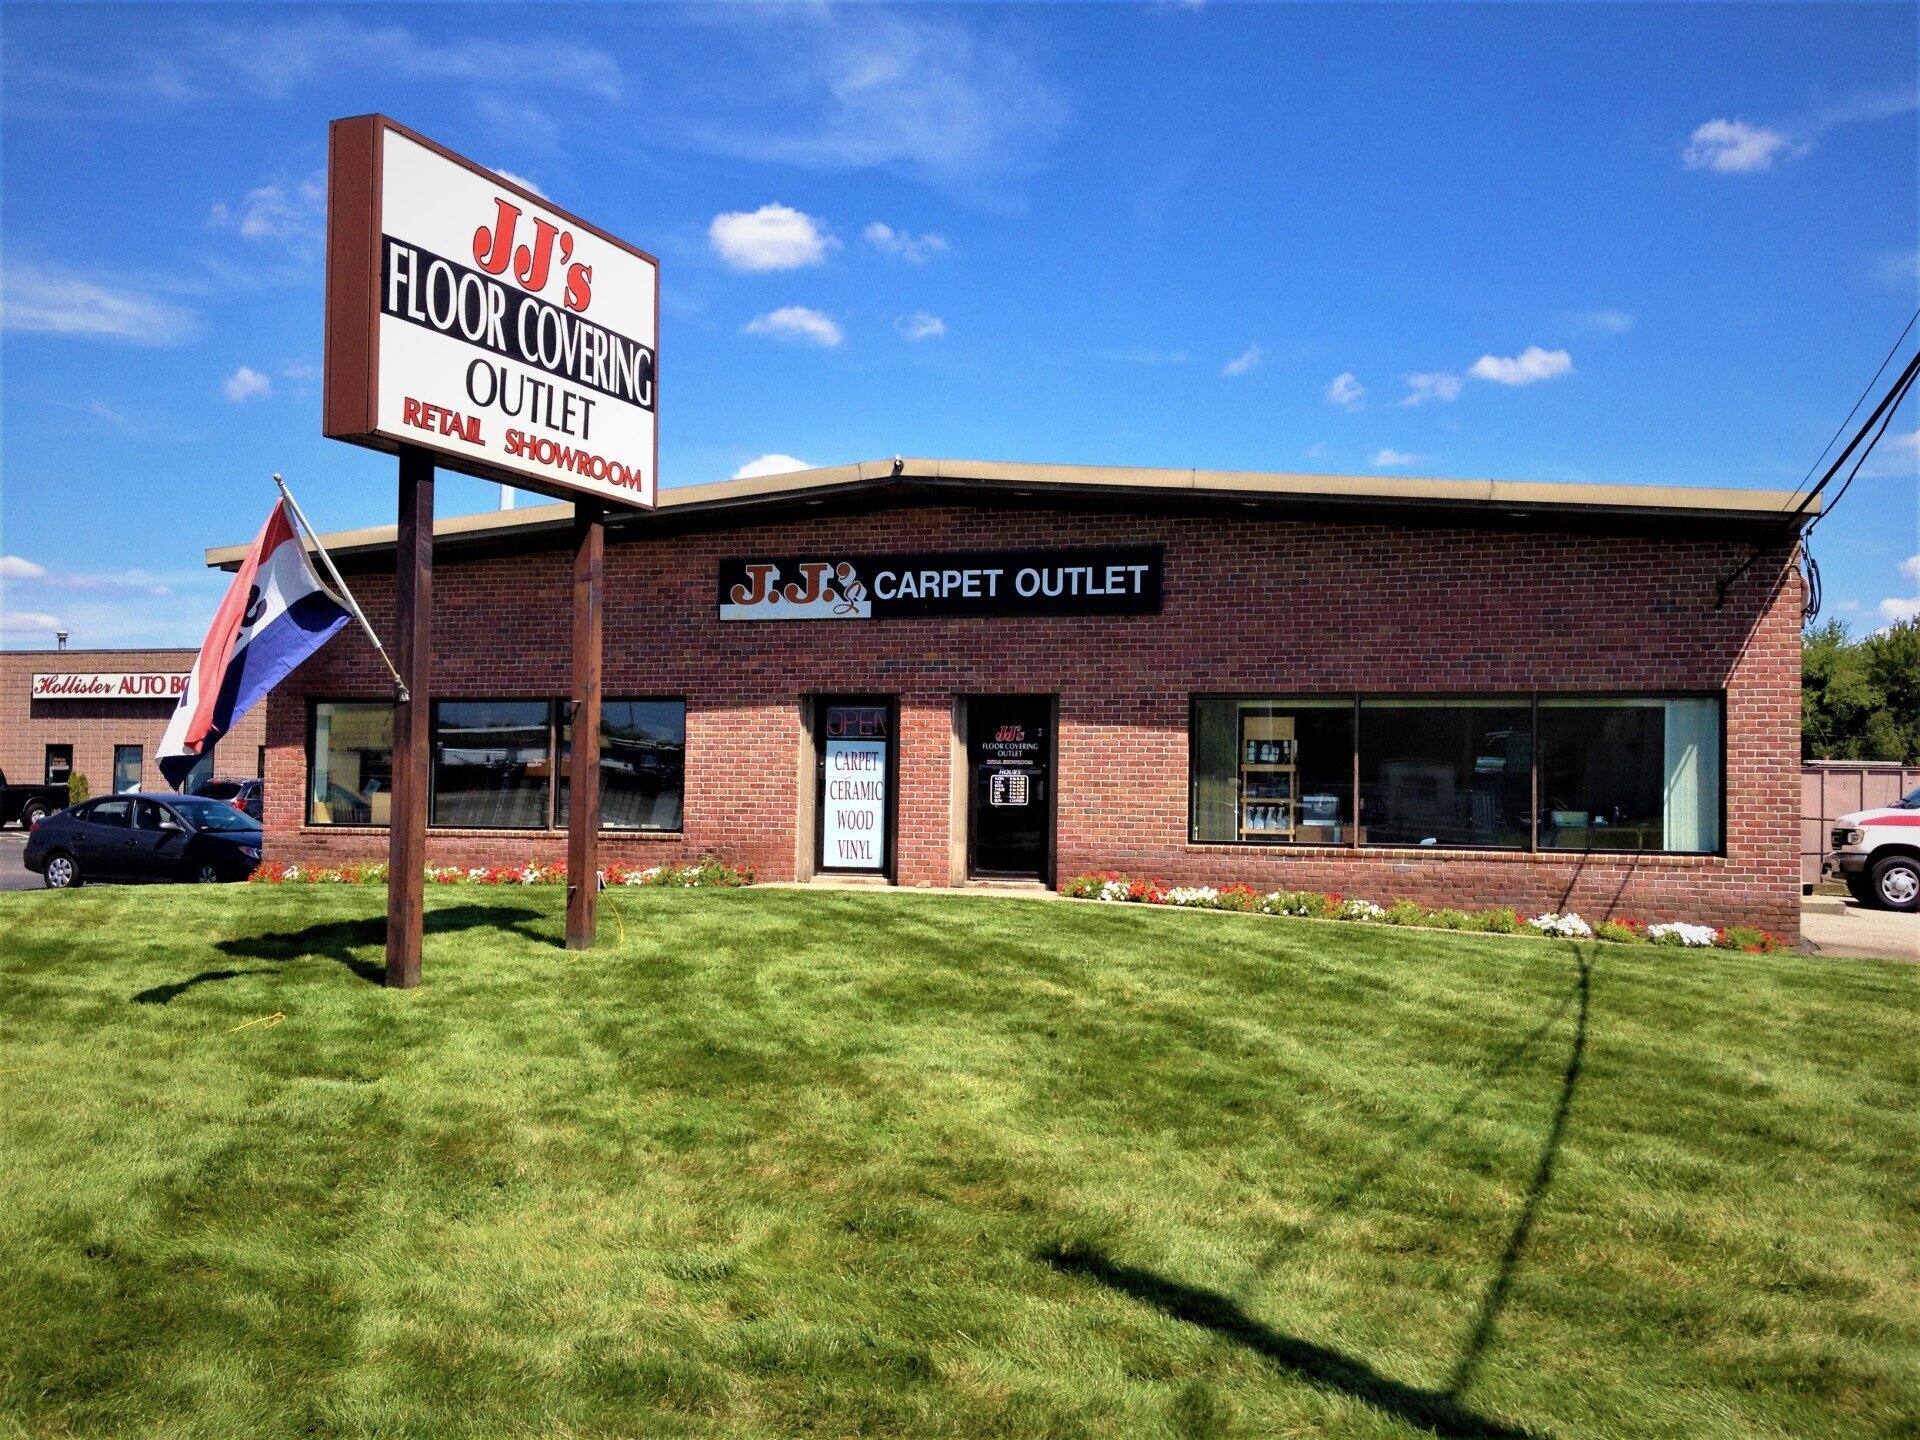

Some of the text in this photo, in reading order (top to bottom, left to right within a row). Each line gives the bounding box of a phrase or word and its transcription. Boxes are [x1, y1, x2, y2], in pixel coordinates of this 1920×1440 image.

[473, 197, 592, 312] JJ's
[388, 242, 652, 406] FLOOR COVERING
[466, 358, 596, 440] OUTLET
[403, 397, 642, 492] RETAIL SHOWROOM
[874, 569, 1003, 599] CARPET
[1015, 565, 1149, 597] OUTLET
[34, 674, 116, 695] Hollister
[118, 676, 166, 695] AUTO
[829, 710, 887, 735] OPEN
[995, 725, 1025, 742] JJ's
[835, 750, 879, 771] CARPET
[830, 780, 883, 801] CERAMIC
[837, 810, 874, 830] WOOD
[838, 839, 873, 860] VINYL
